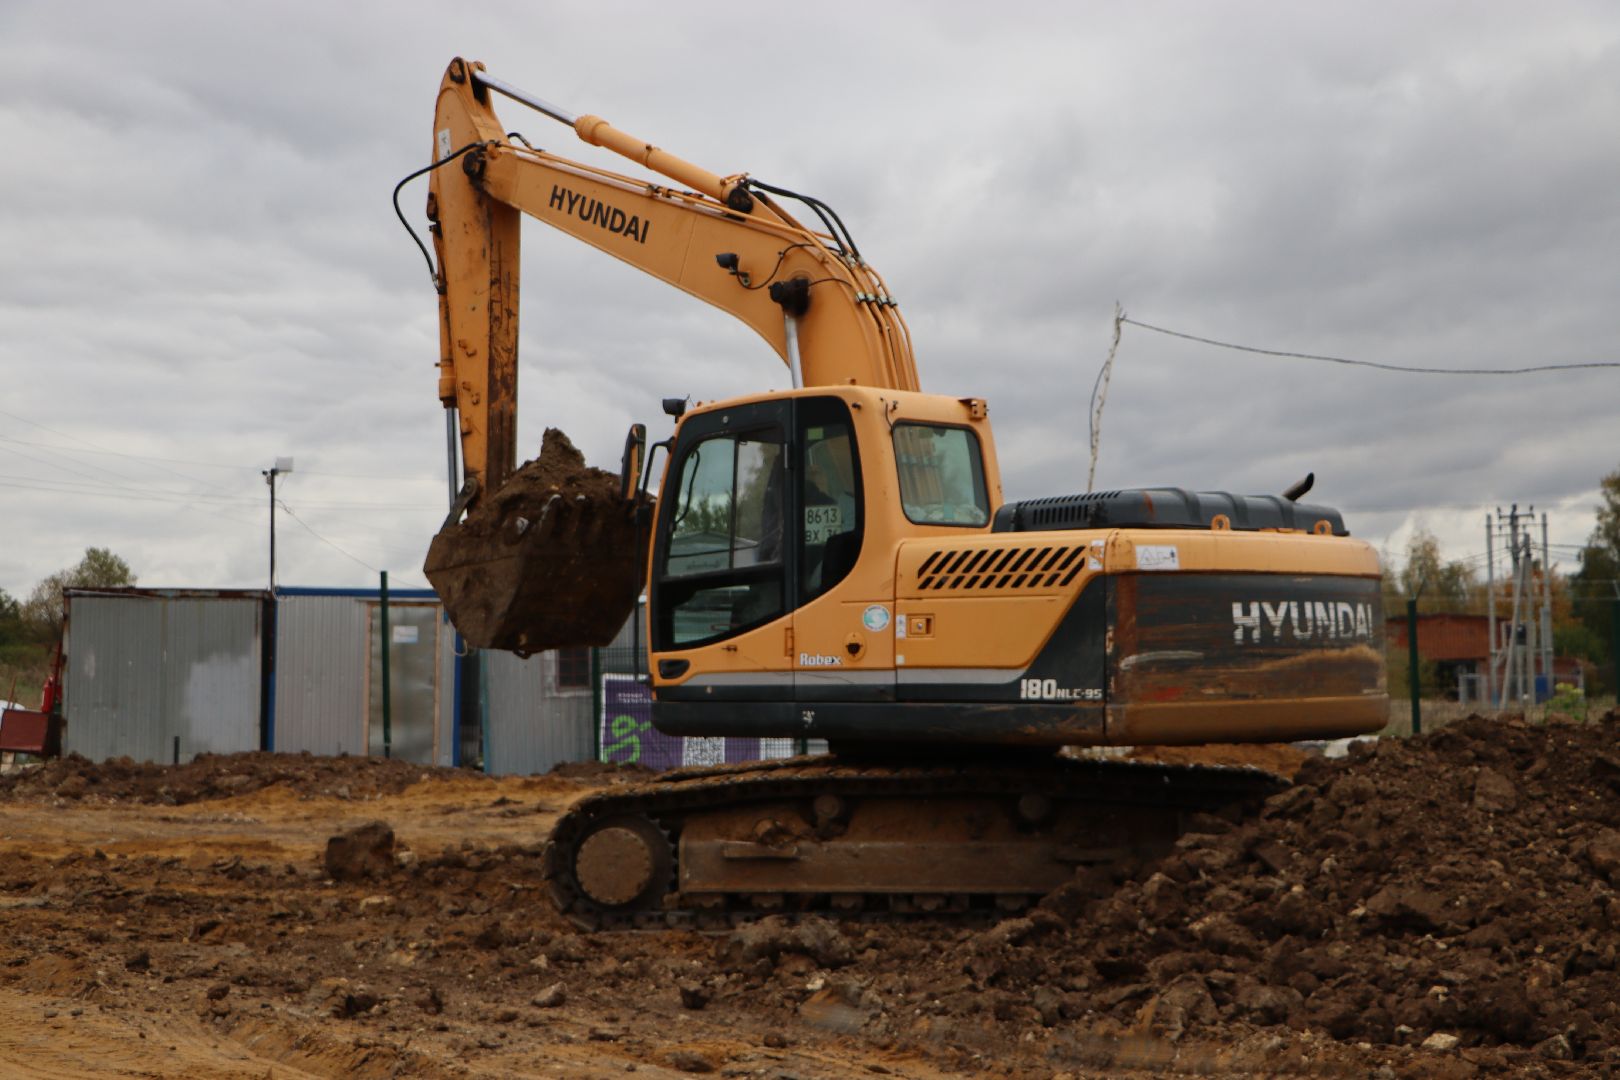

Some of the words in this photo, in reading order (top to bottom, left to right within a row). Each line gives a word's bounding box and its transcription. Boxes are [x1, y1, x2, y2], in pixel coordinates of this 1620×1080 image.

[549, 184, 650, 244] HYUNDAI
[807, 508, 837, 525] 8613
[1232, 601, 1373, 645] HYUNDAI
[799, 652, 842, 667] Robex
